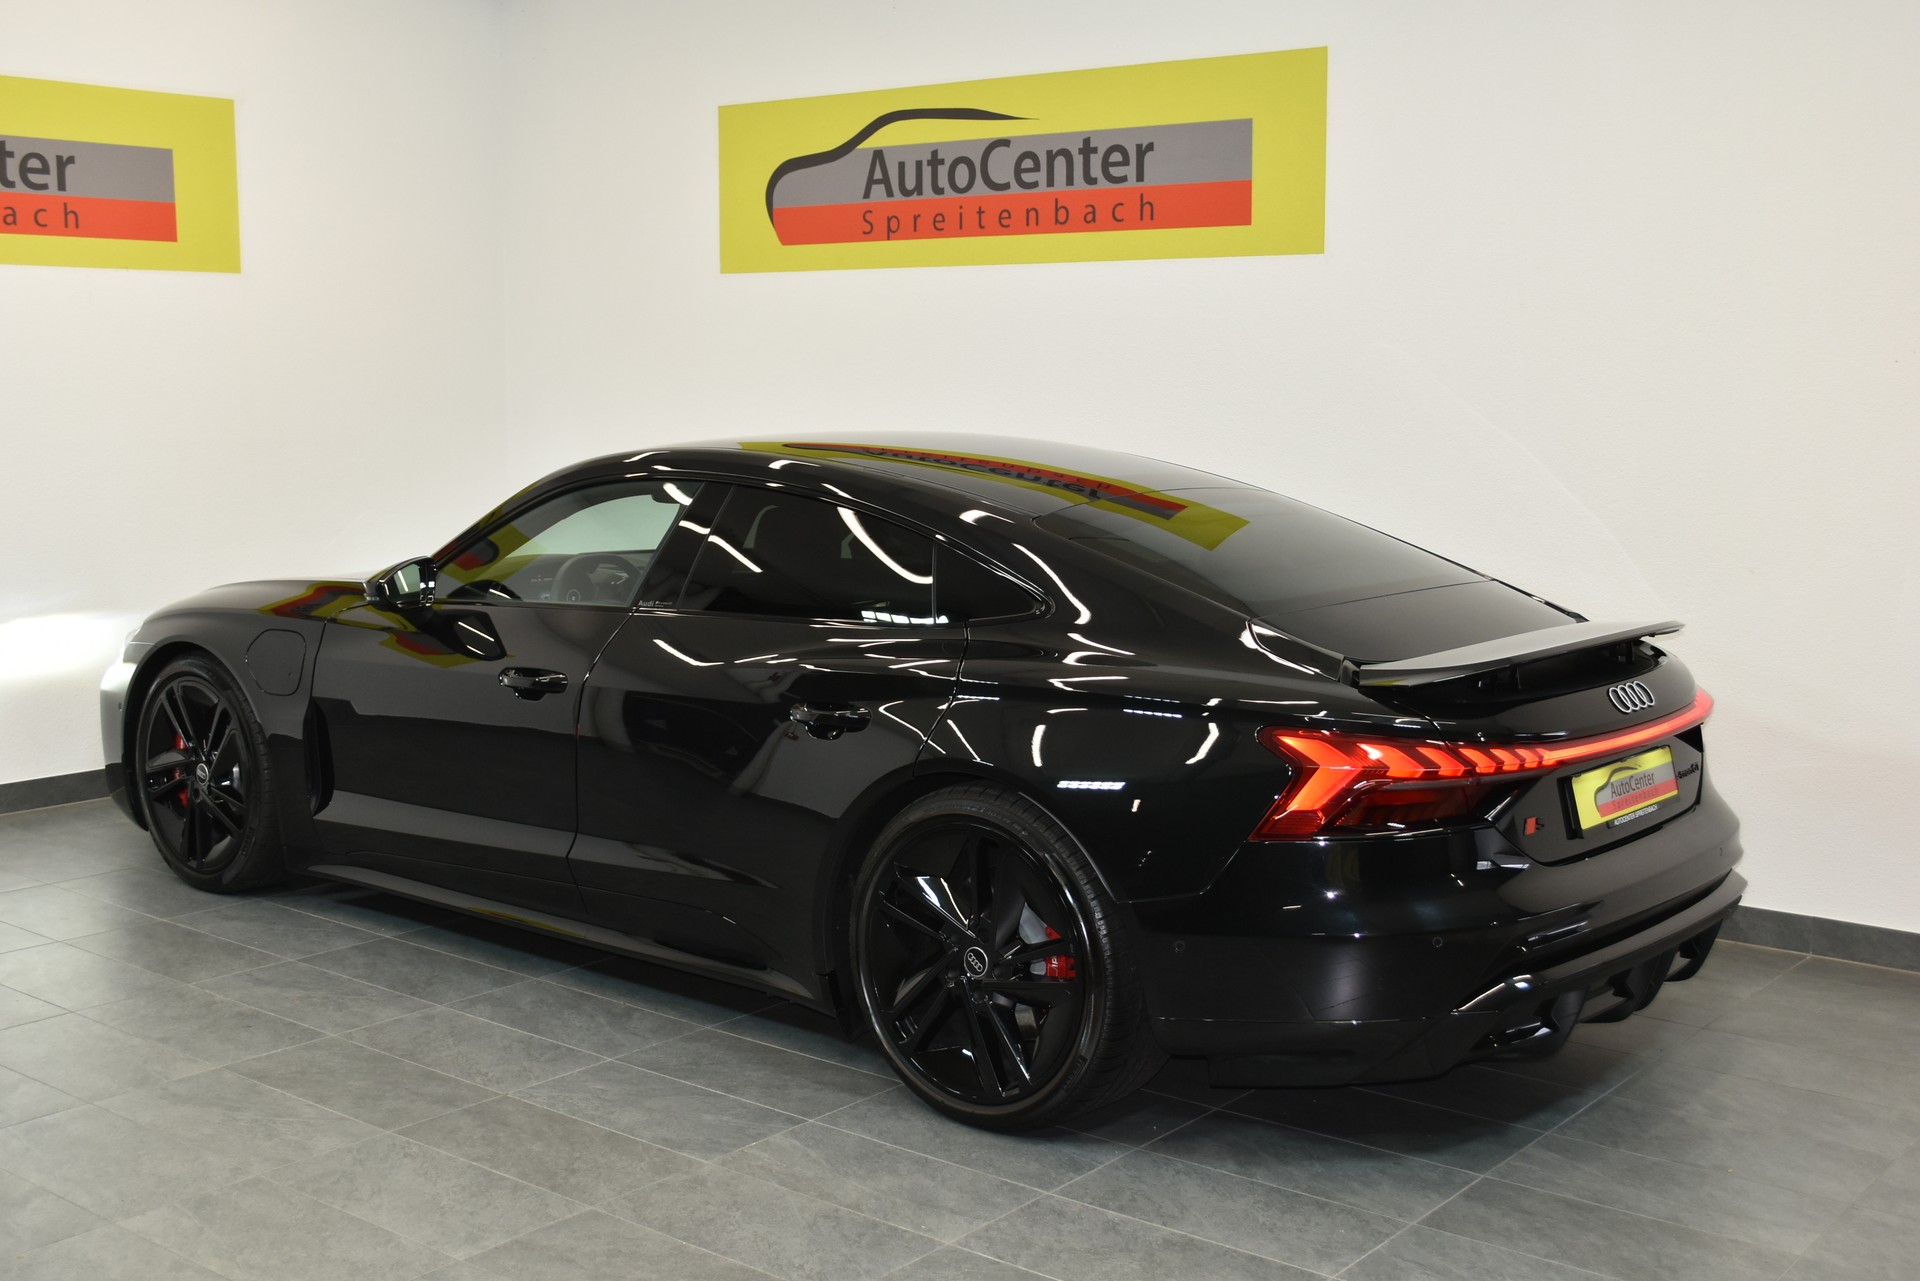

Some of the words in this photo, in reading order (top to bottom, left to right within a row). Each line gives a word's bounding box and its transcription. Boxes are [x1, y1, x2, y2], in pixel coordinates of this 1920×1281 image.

[862, 137, 1155, 200] AutoCenter
[862, 193, 1155, 240] Spreitenbach
[1610, 773, 1656, 799] AutoCenter
